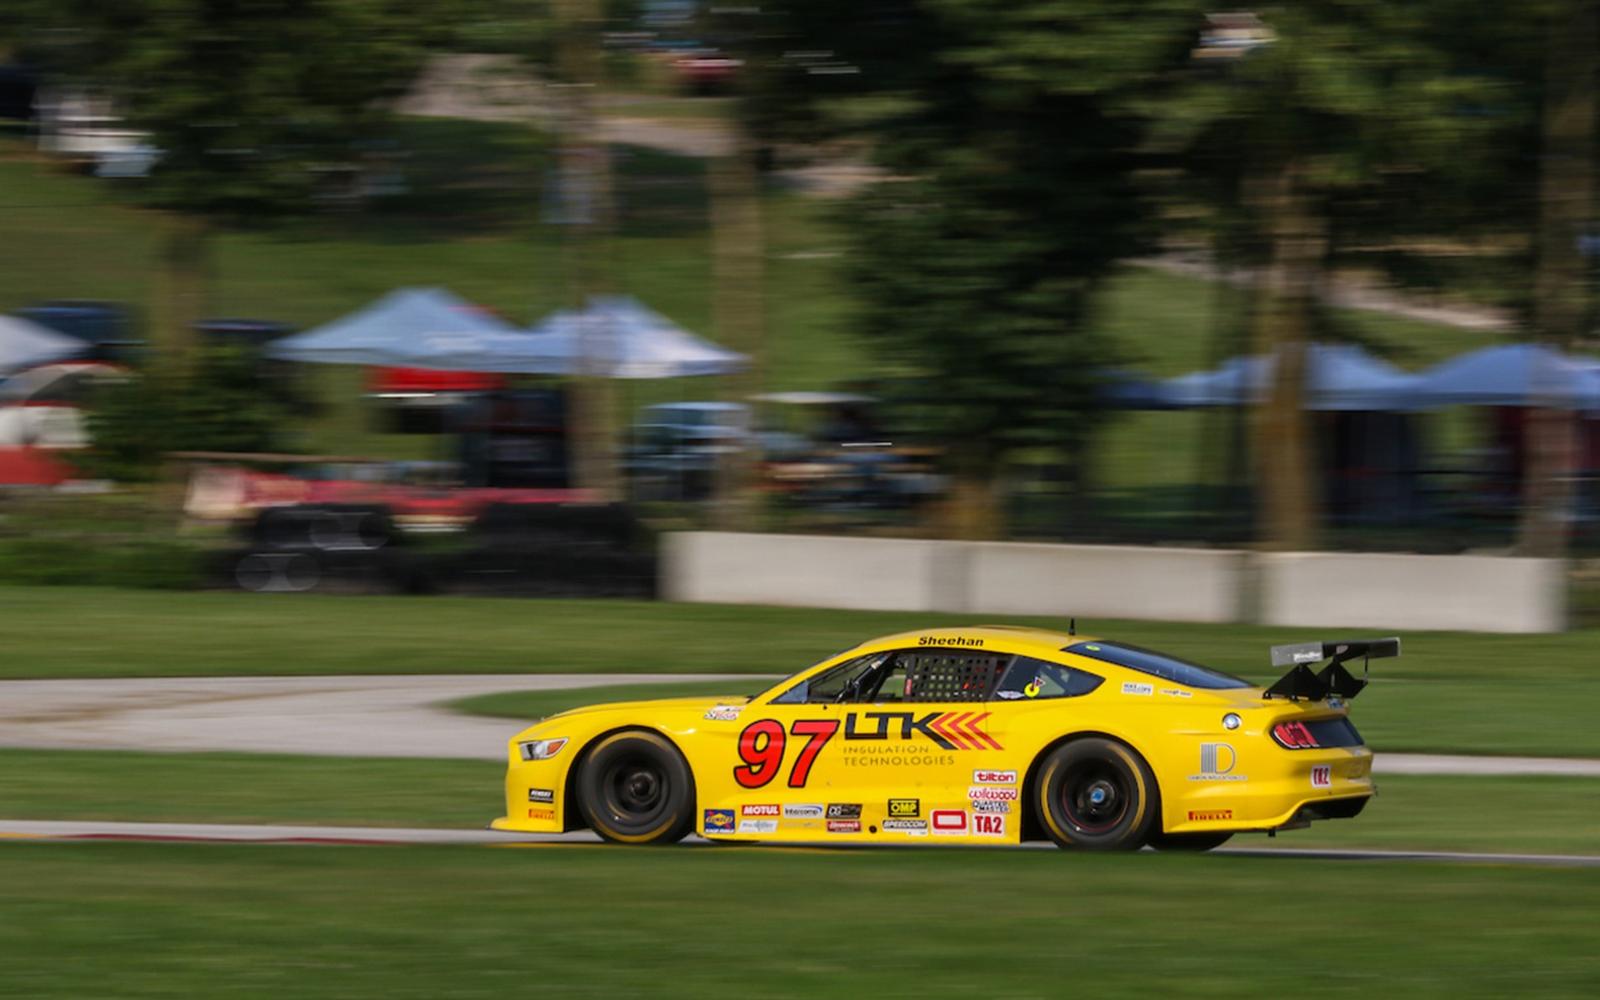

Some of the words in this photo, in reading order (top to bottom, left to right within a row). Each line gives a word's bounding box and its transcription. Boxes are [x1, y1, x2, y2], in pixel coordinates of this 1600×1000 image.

[918, 636, 984, 647] Sheehan
[844, 712, 959, 751] LTK
[734, 718, 841, 789] 97
[843, 745, 929, 755] INSULATION
[843, 755, 955, 767] TECHNOLOGIES
[977, 772, 1015, 782] tilton
[969, 787, 1017, 800] wilwood
[743, 805, 779, 815] MOTUL
[890, 803, 917, 813] OMP
[974, 815, 1003, 833] TA2
